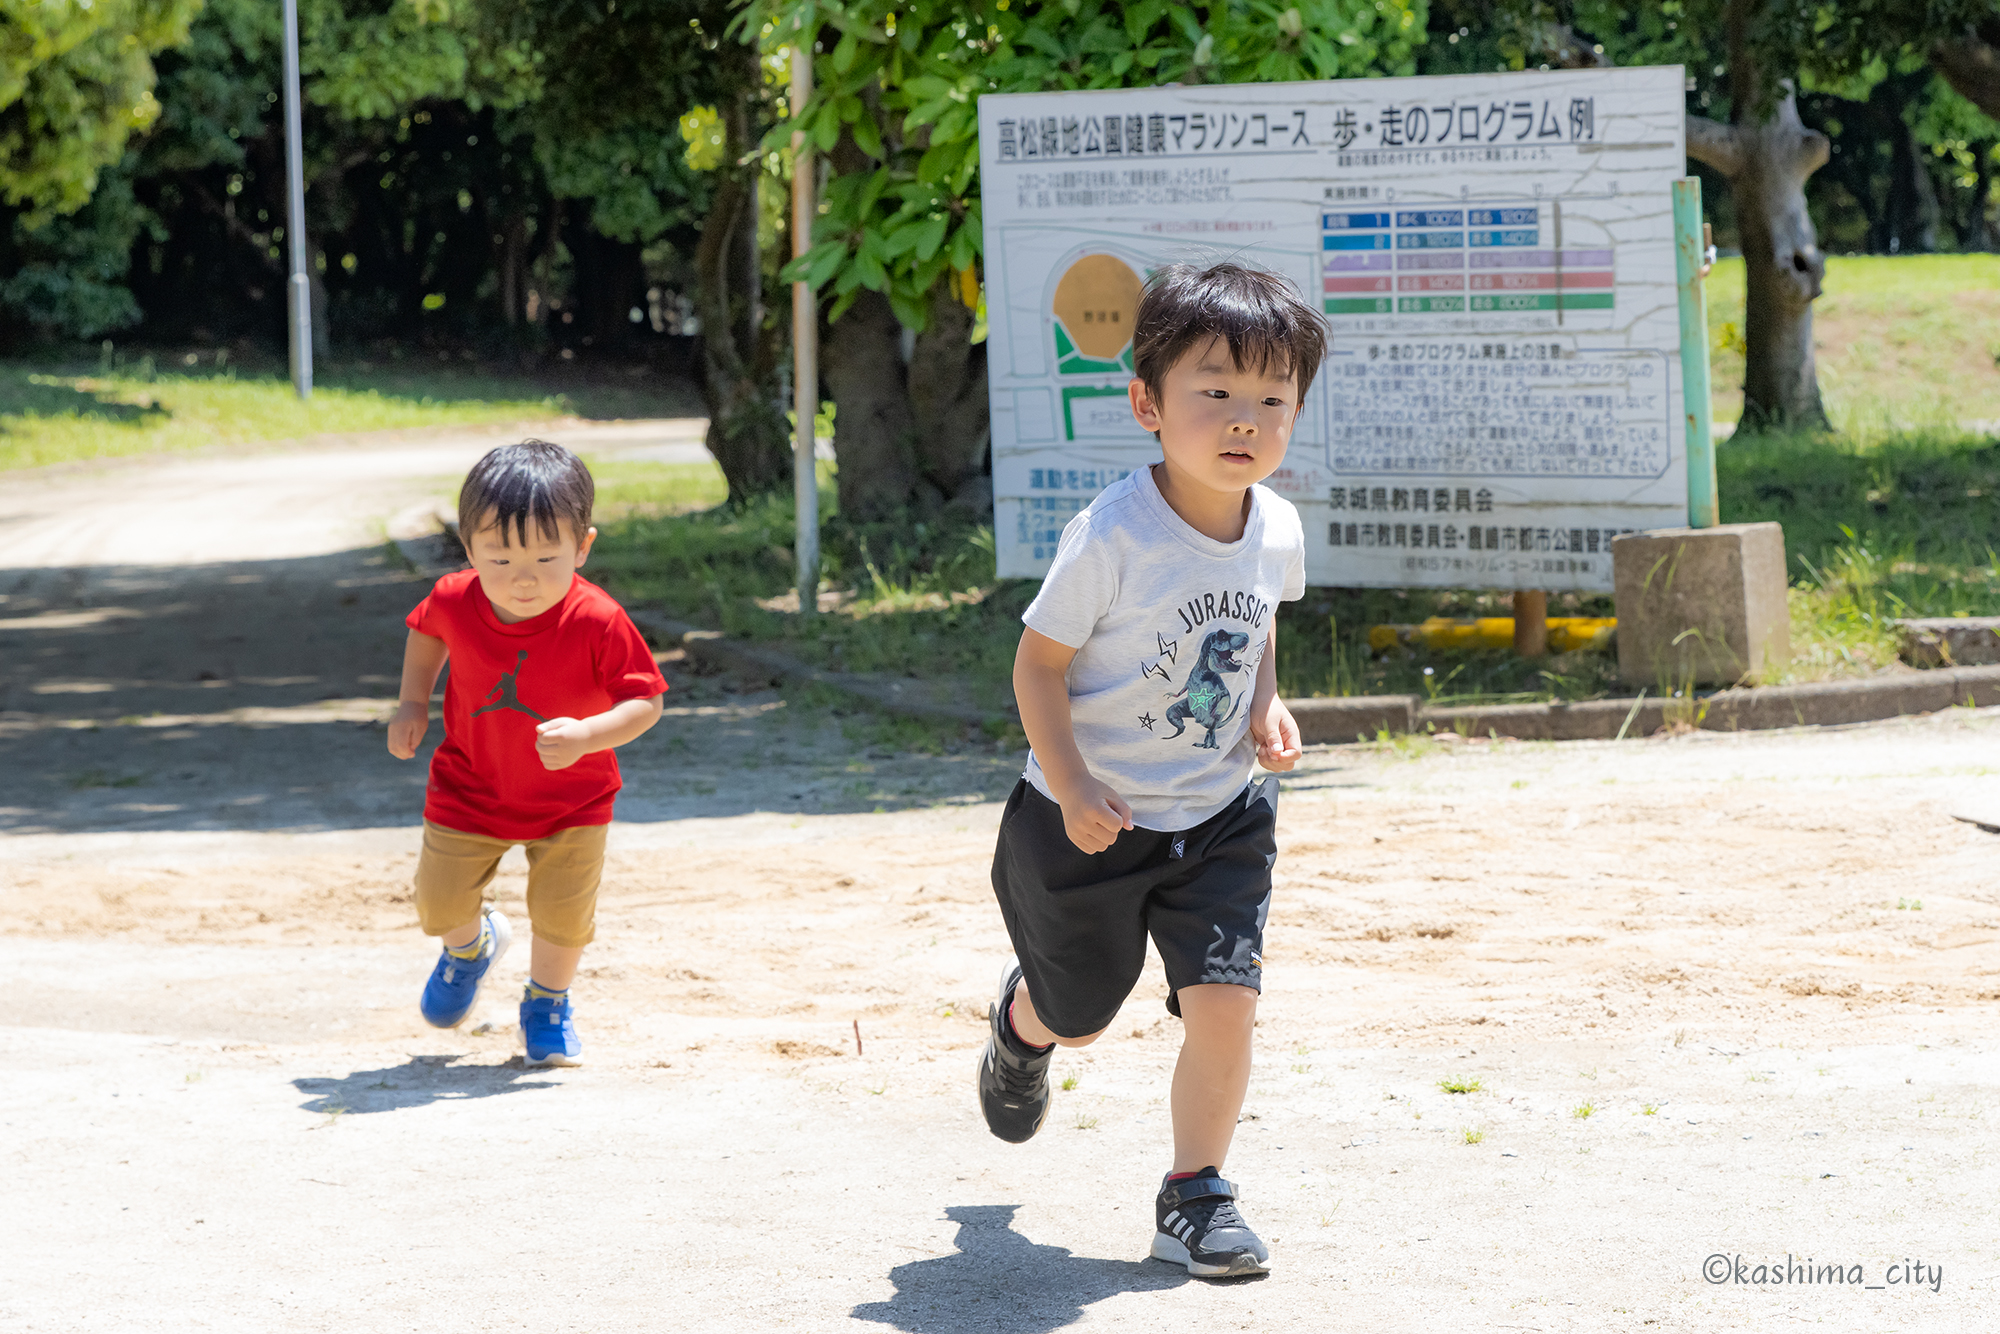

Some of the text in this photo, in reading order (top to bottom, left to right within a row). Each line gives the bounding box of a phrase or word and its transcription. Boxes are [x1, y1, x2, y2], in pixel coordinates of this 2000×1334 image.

[997, 97, 1594, 159] 高松緑地公園健康マラソンコース 歩・走のプログラム例
[1425, 212, 1462, 226] 100%
[1470, 211, 1493, 225] 走る
[1471, 233, 1493, 246] 走る
[1375, 278, 1386, 290] 4
[1400, 277, 1422, 291] 走る
[1472, 275, 1494, 289] 走る
[1400, 299, 1423, 312] 走る
[1473, 296, 1494, 310] 走る
[1368, 343, 1562, 361] 歩・走のプログラム実施上の注意
[1328, 487, 1494, 512] 茨城県教育委員会
[1328, 522, 1635, 553] 鹿嶋市教育委員会・鹿嶋市都市公園管理
[1177, 590, 1268, 634] JURASSIC
